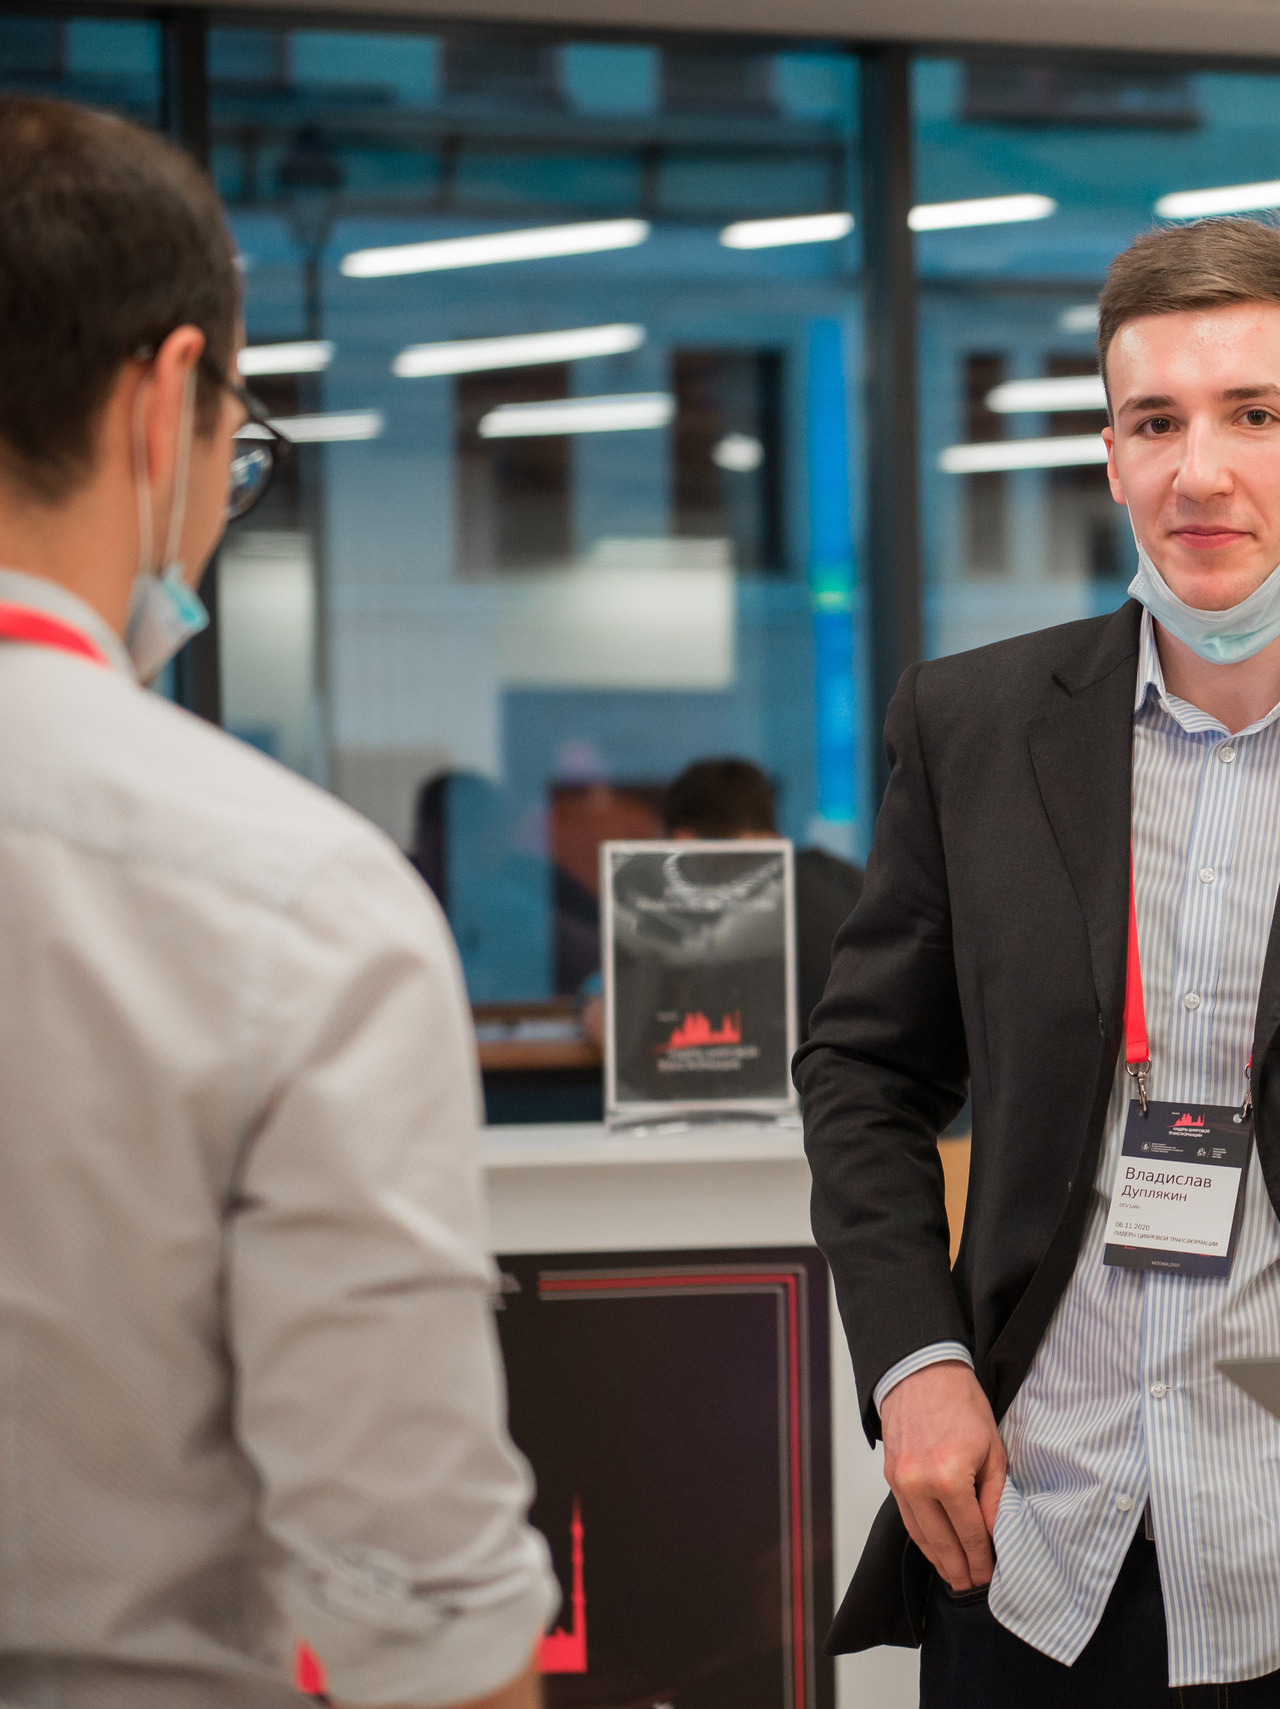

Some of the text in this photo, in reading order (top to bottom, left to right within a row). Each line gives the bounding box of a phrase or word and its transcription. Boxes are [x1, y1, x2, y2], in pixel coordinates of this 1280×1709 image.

[1125, 1167, 1212, 1189] Владислав
[1121, 1185, 1188, 1202] Дуплякин
[1114, 1221, 1151, 1231] 06.11.2020
[1113, 1230, 1219, 1247] ЛИДЕРЫ ЦИФРОВОЙ ТРАНСФОРМАЦИИ
